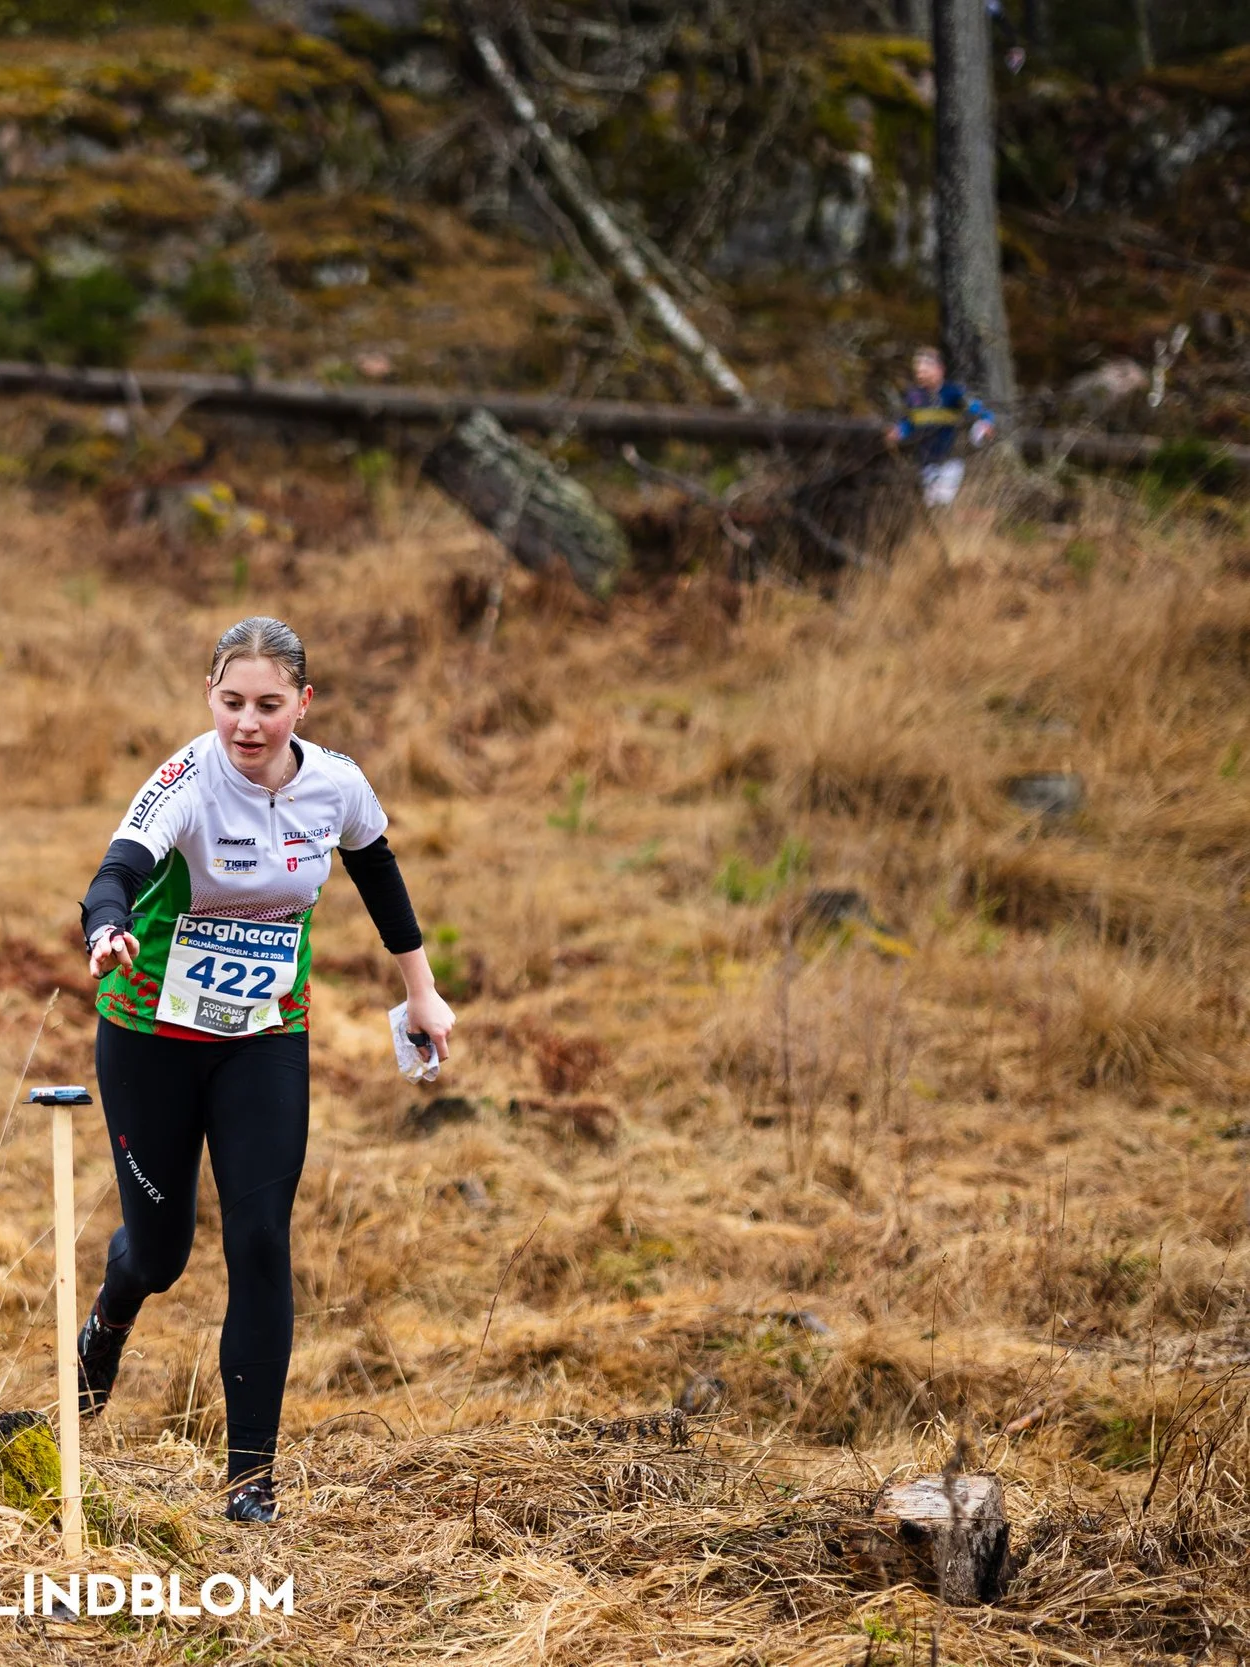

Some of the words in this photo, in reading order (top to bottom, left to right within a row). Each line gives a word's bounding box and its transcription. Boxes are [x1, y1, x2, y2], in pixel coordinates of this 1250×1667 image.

[144, 795, 171, 834] MOUNTAIN
[217, 837, 256, 846] TRIMTEX
[180, 918, 297, 947] bagheera
[188, 938, 249, 956] KOLMÅRDSMEDELN
[260, 951, 269, 959] #2
[270, 952, 285, 960] 2026
[186, 956, 276, 999] 422
[126, 1150, 165, 1204] TRIMTEX
